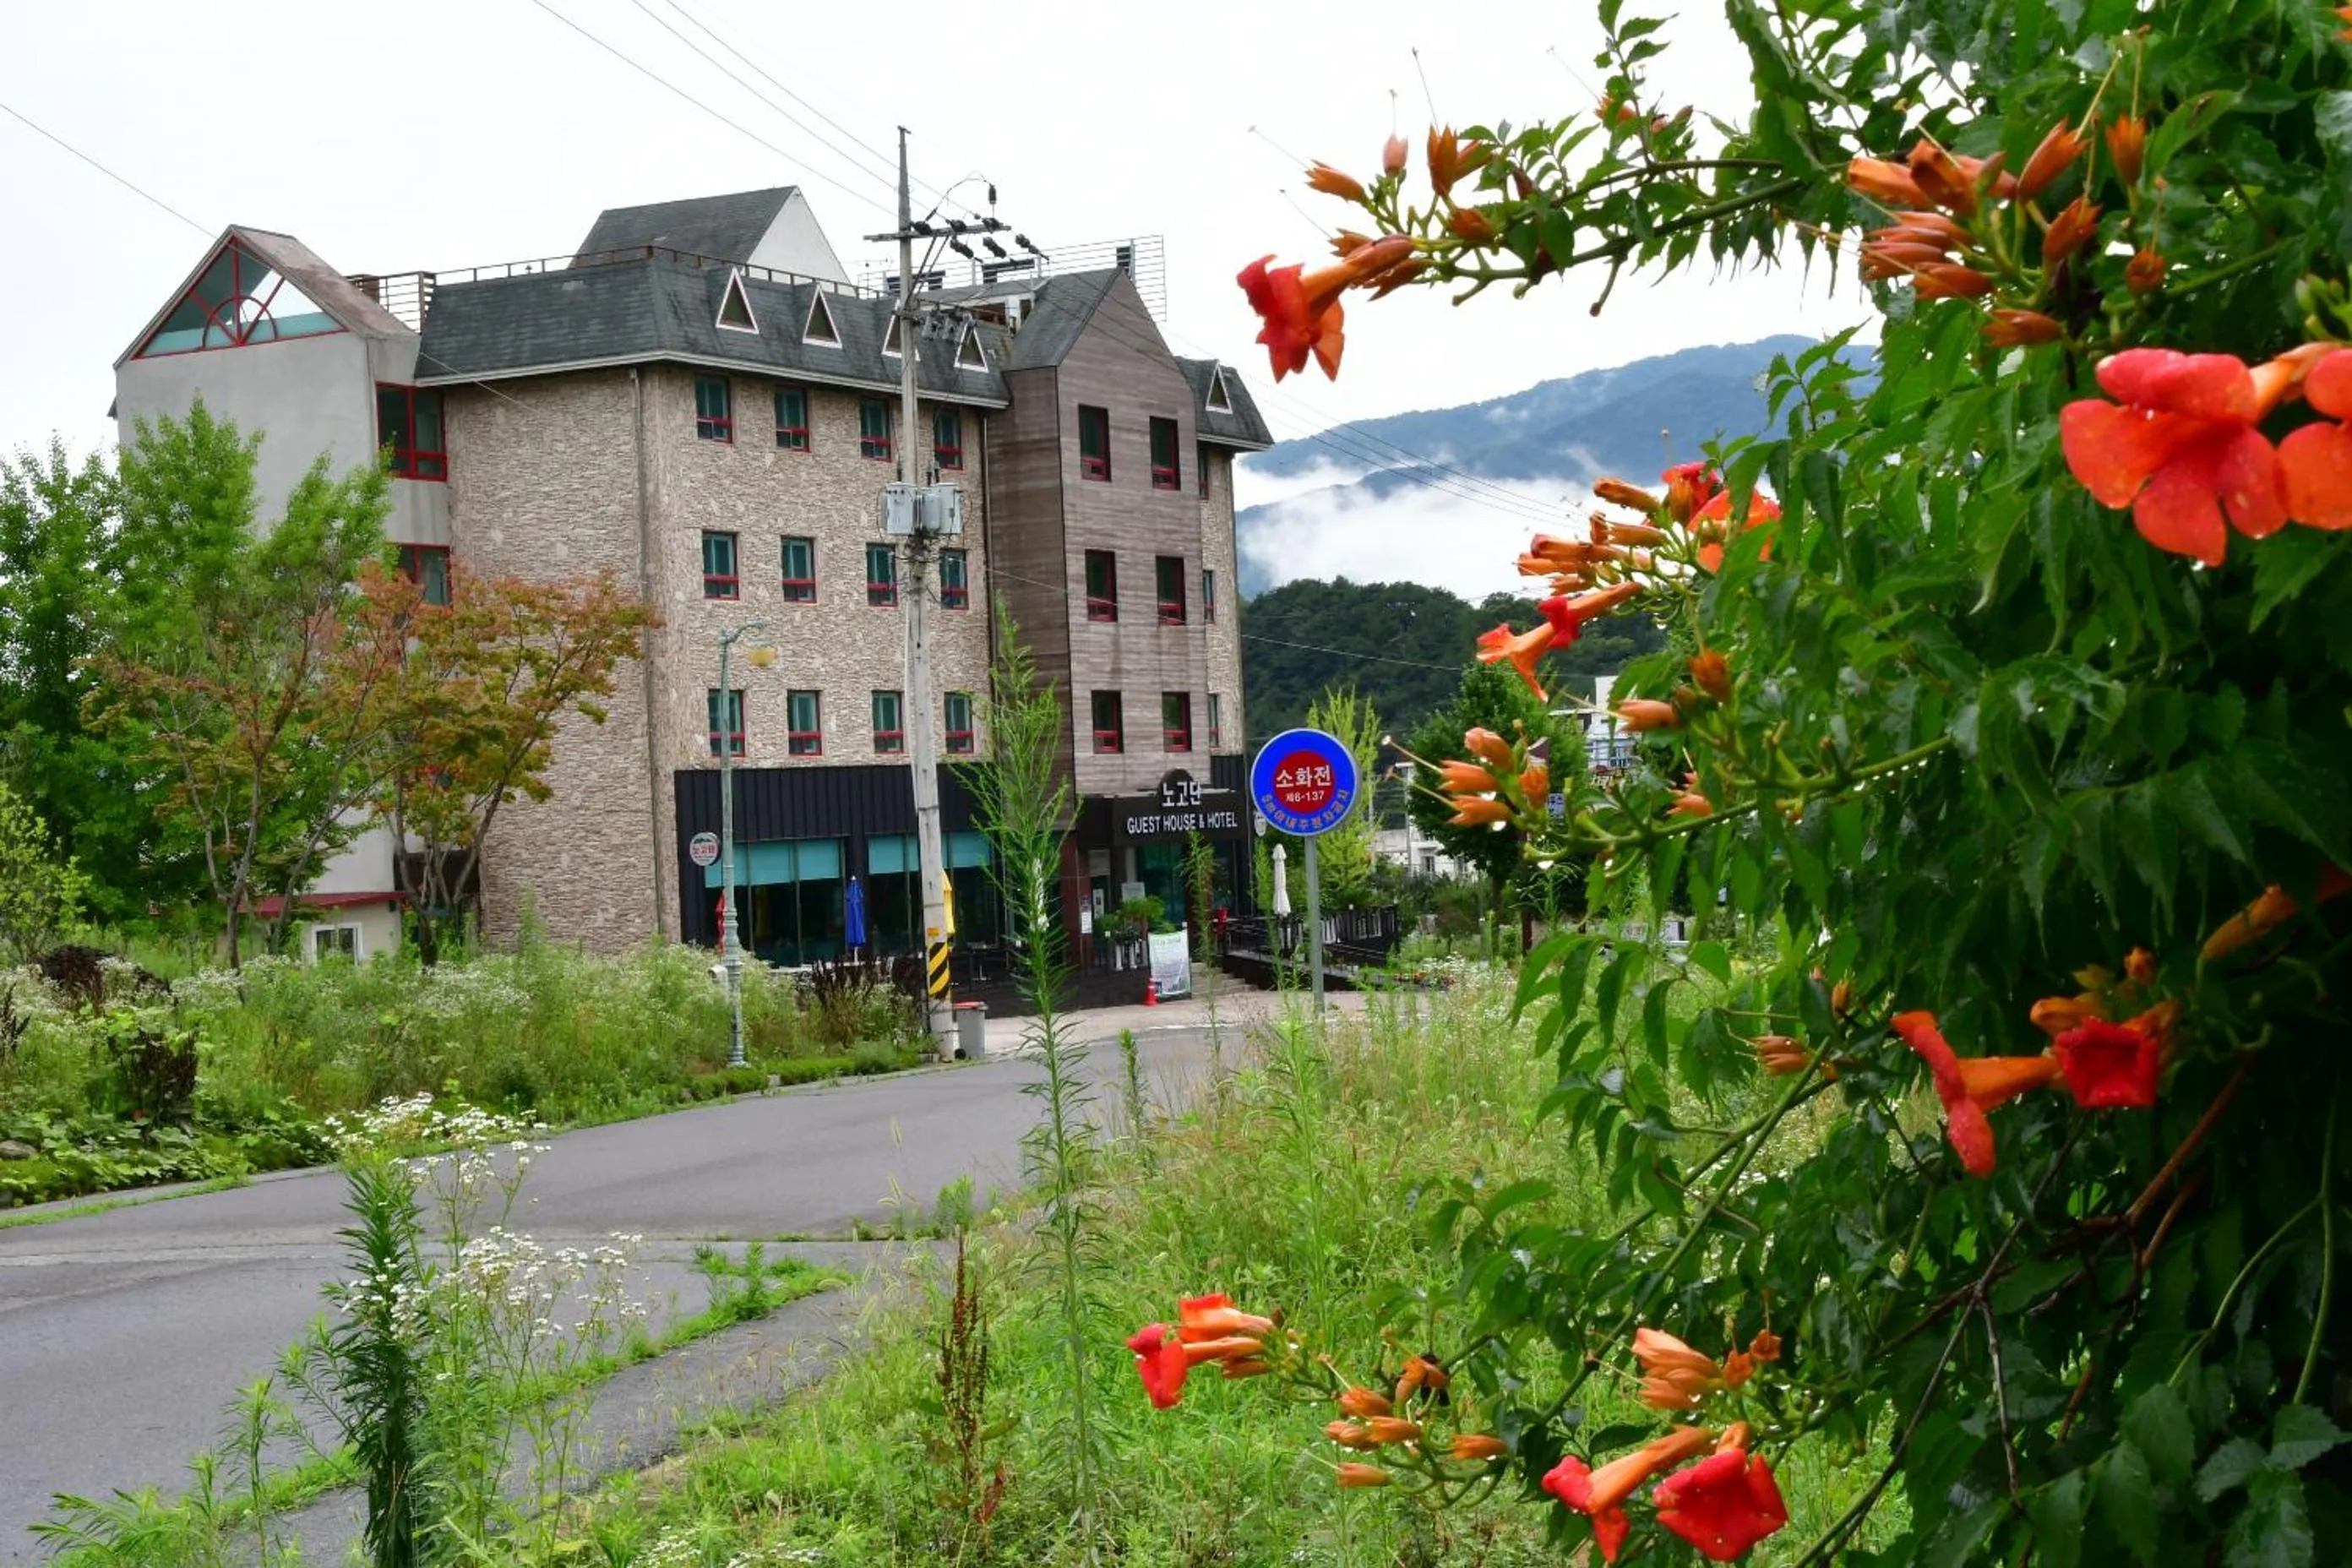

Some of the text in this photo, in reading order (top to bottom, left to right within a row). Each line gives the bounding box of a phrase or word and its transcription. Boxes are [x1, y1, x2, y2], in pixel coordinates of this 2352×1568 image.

[1276, 765, 1331, 787] 소화전
[1162, 781, 1201, 807] 노고단
[1127, 816, 1161, 834] GUEST
[1162, 814, 1195, 831] HOUSE
[1200, 814, 1205, 828] &
[1207, 812, 1238, 828] HOTEL
